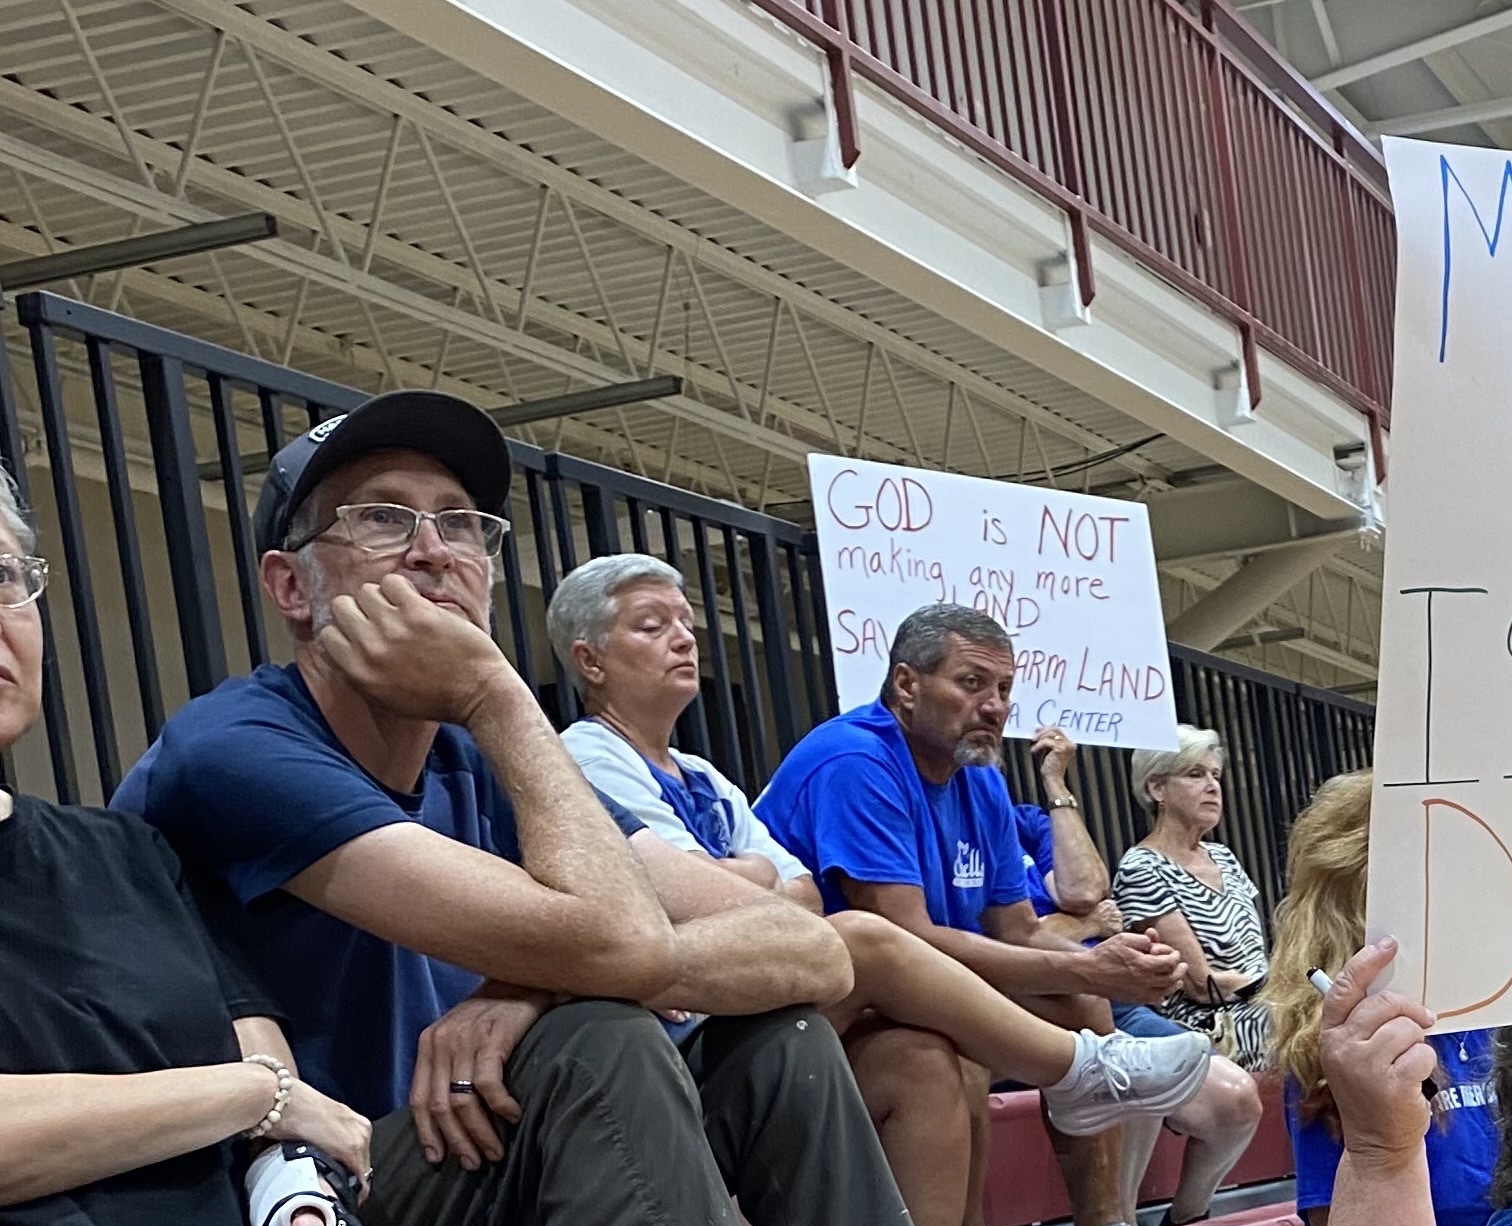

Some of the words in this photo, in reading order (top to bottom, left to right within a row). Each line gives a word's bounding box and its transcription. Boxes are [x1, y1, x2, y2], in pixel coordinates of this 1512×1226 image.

[827, 469, 934, 531] GOD
[982, 508, 1008, 546] is
[1037, 504, 1130, 563] NOT
[837, 537, 946, 603] making
[969, 565, 1015, 605] any
[1036, 570, 1110, 601] more
[1007, 633, 1067, 694] ARM
[1077, 646, 1165, 701] LAND
[1036, 700, 1123, 742] CENTER
